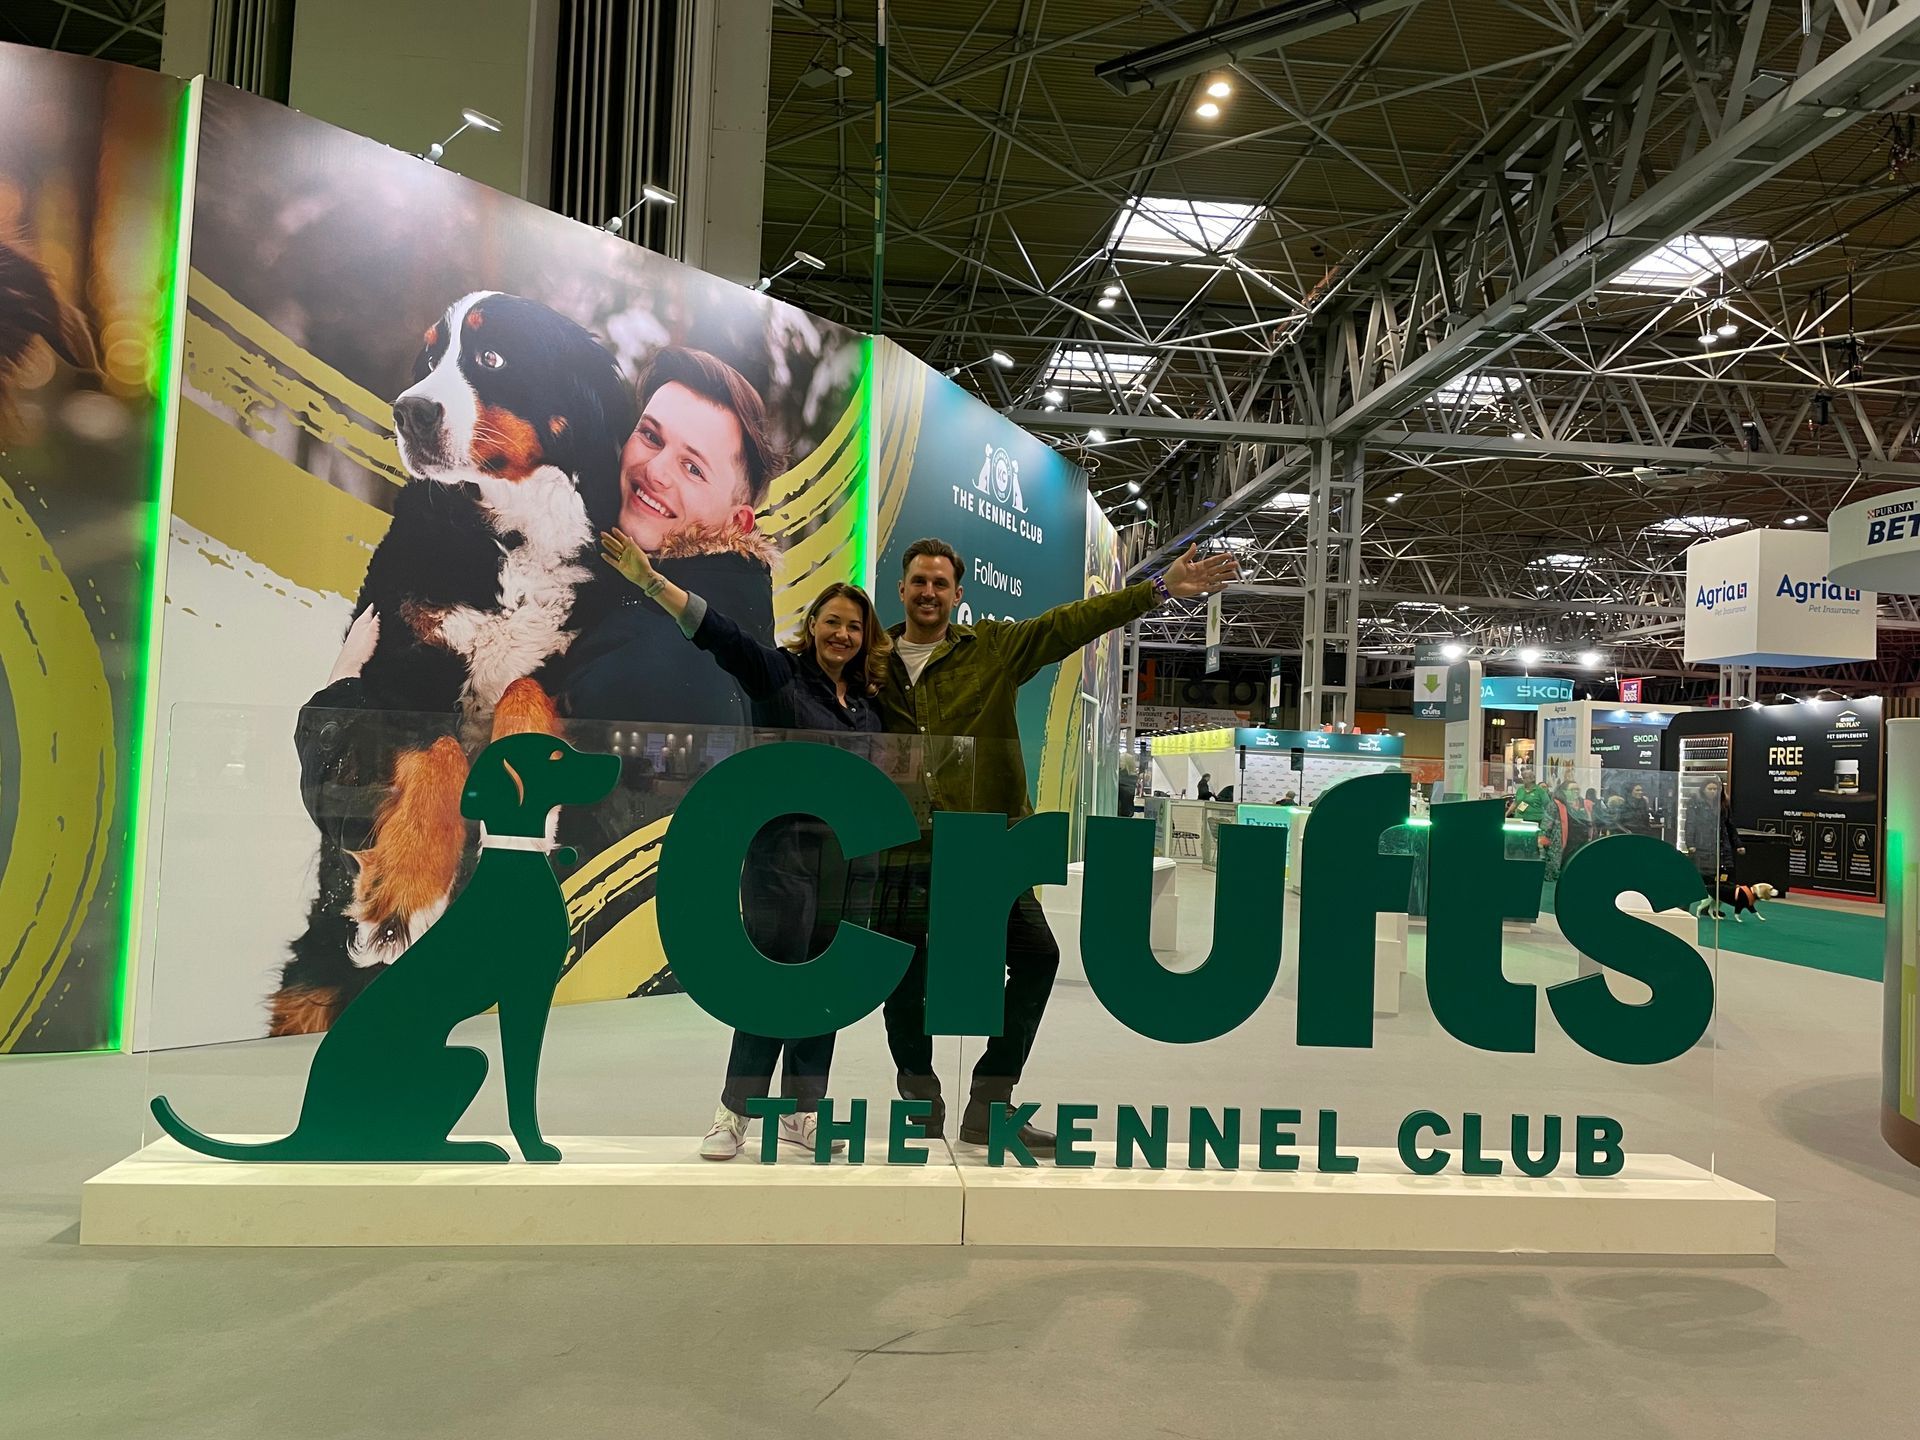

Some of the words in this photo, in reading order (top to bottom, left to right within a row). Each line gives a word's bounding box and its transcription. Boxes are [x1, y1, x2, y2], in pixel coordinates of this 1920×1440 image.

[952, 485, 974, 512] THE
[978, 498, 1017, 533] KENNEL
[1019, 519, 1043, 544] CLUB
[1875, 503, 1913, 517] PURINA
[974, 557, 1008, 592] Follow
[1009, 577, 1022, 597] us
[1775, 573, 1843, 604] Agria
[1695, 580, 1735, 610] Agria
[1808, 604, 1821, 613] Pet
[1822, 604, 1861, 615] Insurance
[1714, 608, 1722, 616] Pet
[1722, 605, 1747, 615] Insurance
[1836, 732, 1869, 740] SUPPLEMENTS
[1768, 746, 1804, 766] FREE
[656, 740, 1716, 1066] Crufts
[745, 1097, 933, 1166] THE
[987, 1101, 1360, 1174] KENNEL
[1396, 1109, 1626, 1178] CLUB
